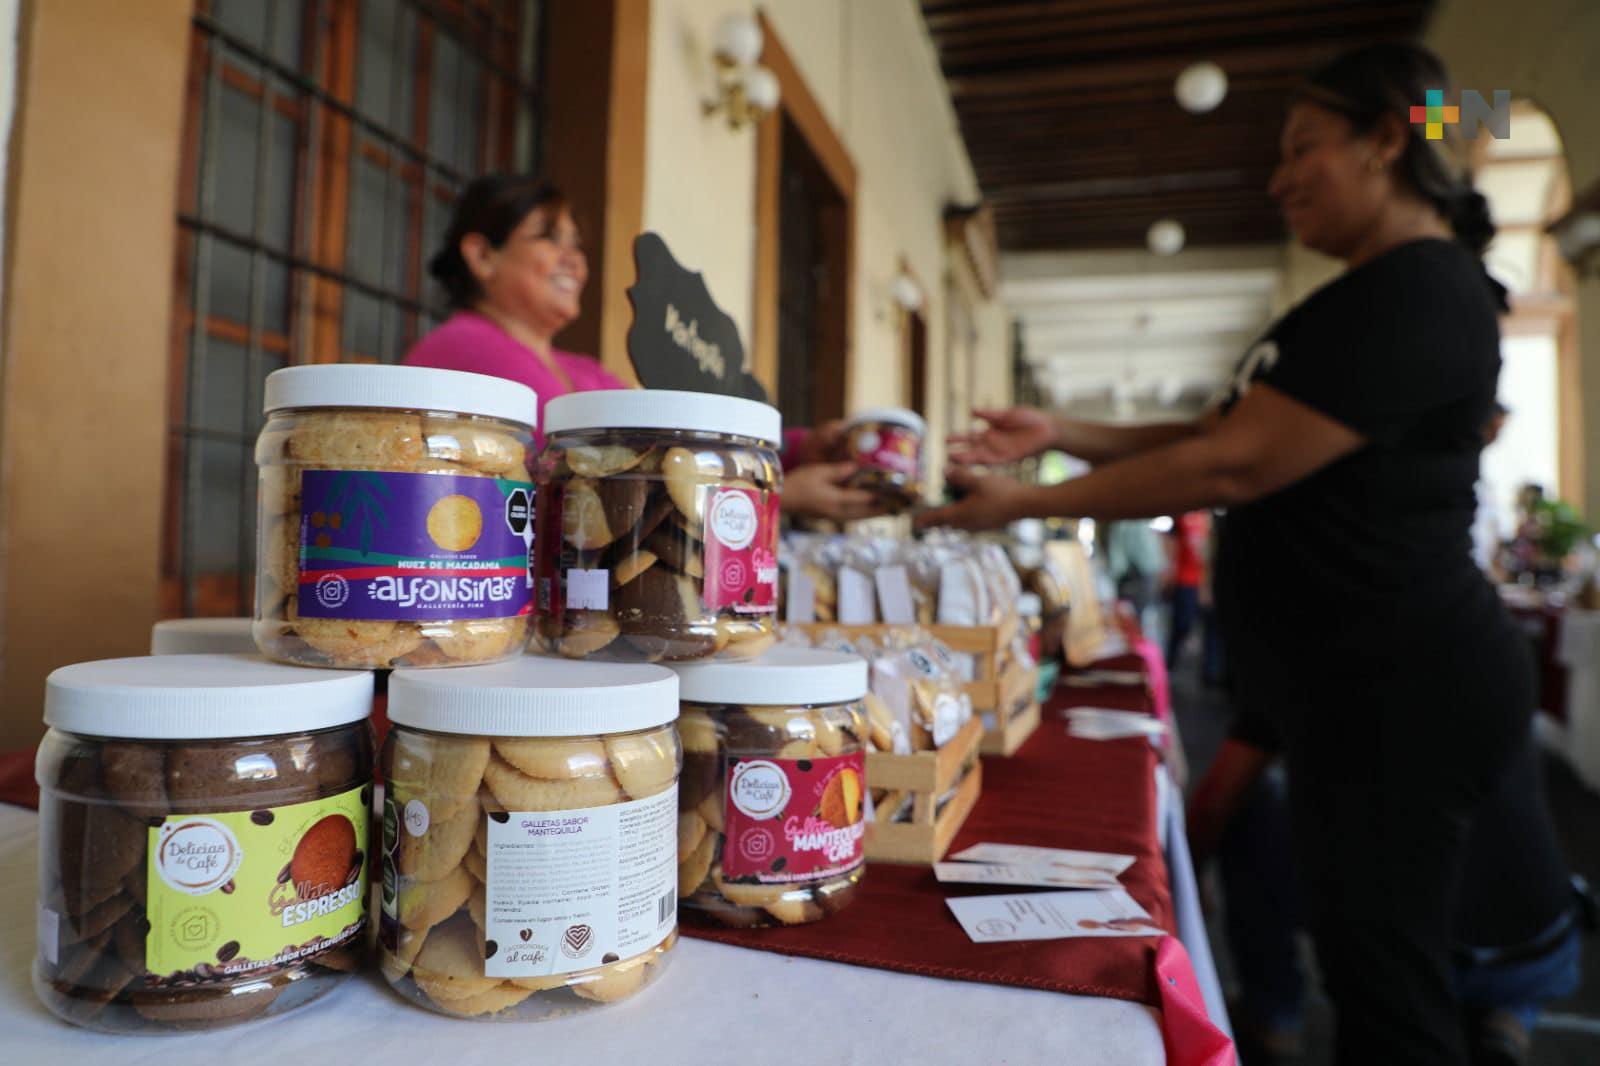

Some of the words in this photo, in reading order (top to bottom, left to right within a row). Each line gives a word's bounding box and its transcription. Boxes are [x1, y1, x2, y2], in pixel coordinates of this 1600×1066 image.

[398, 561, 426, 569] NUEZ
[429, 561, 443, 570] DE
[446, 561, 500, 570] MACADAMIA
[521, 819, 560, 829] GALLETAS
[562, 816, 589, 826] SABOR
[528, 825, 583, 837] MANTEQUILLA
[169, 842, 225, 856] Delicias
[187, 854, 218, 874] Café
[282, 881, 361, 928] ESPRESSO
[506, 951, 519, 963] al
[224, 961, 271, 975] GALLETAS
